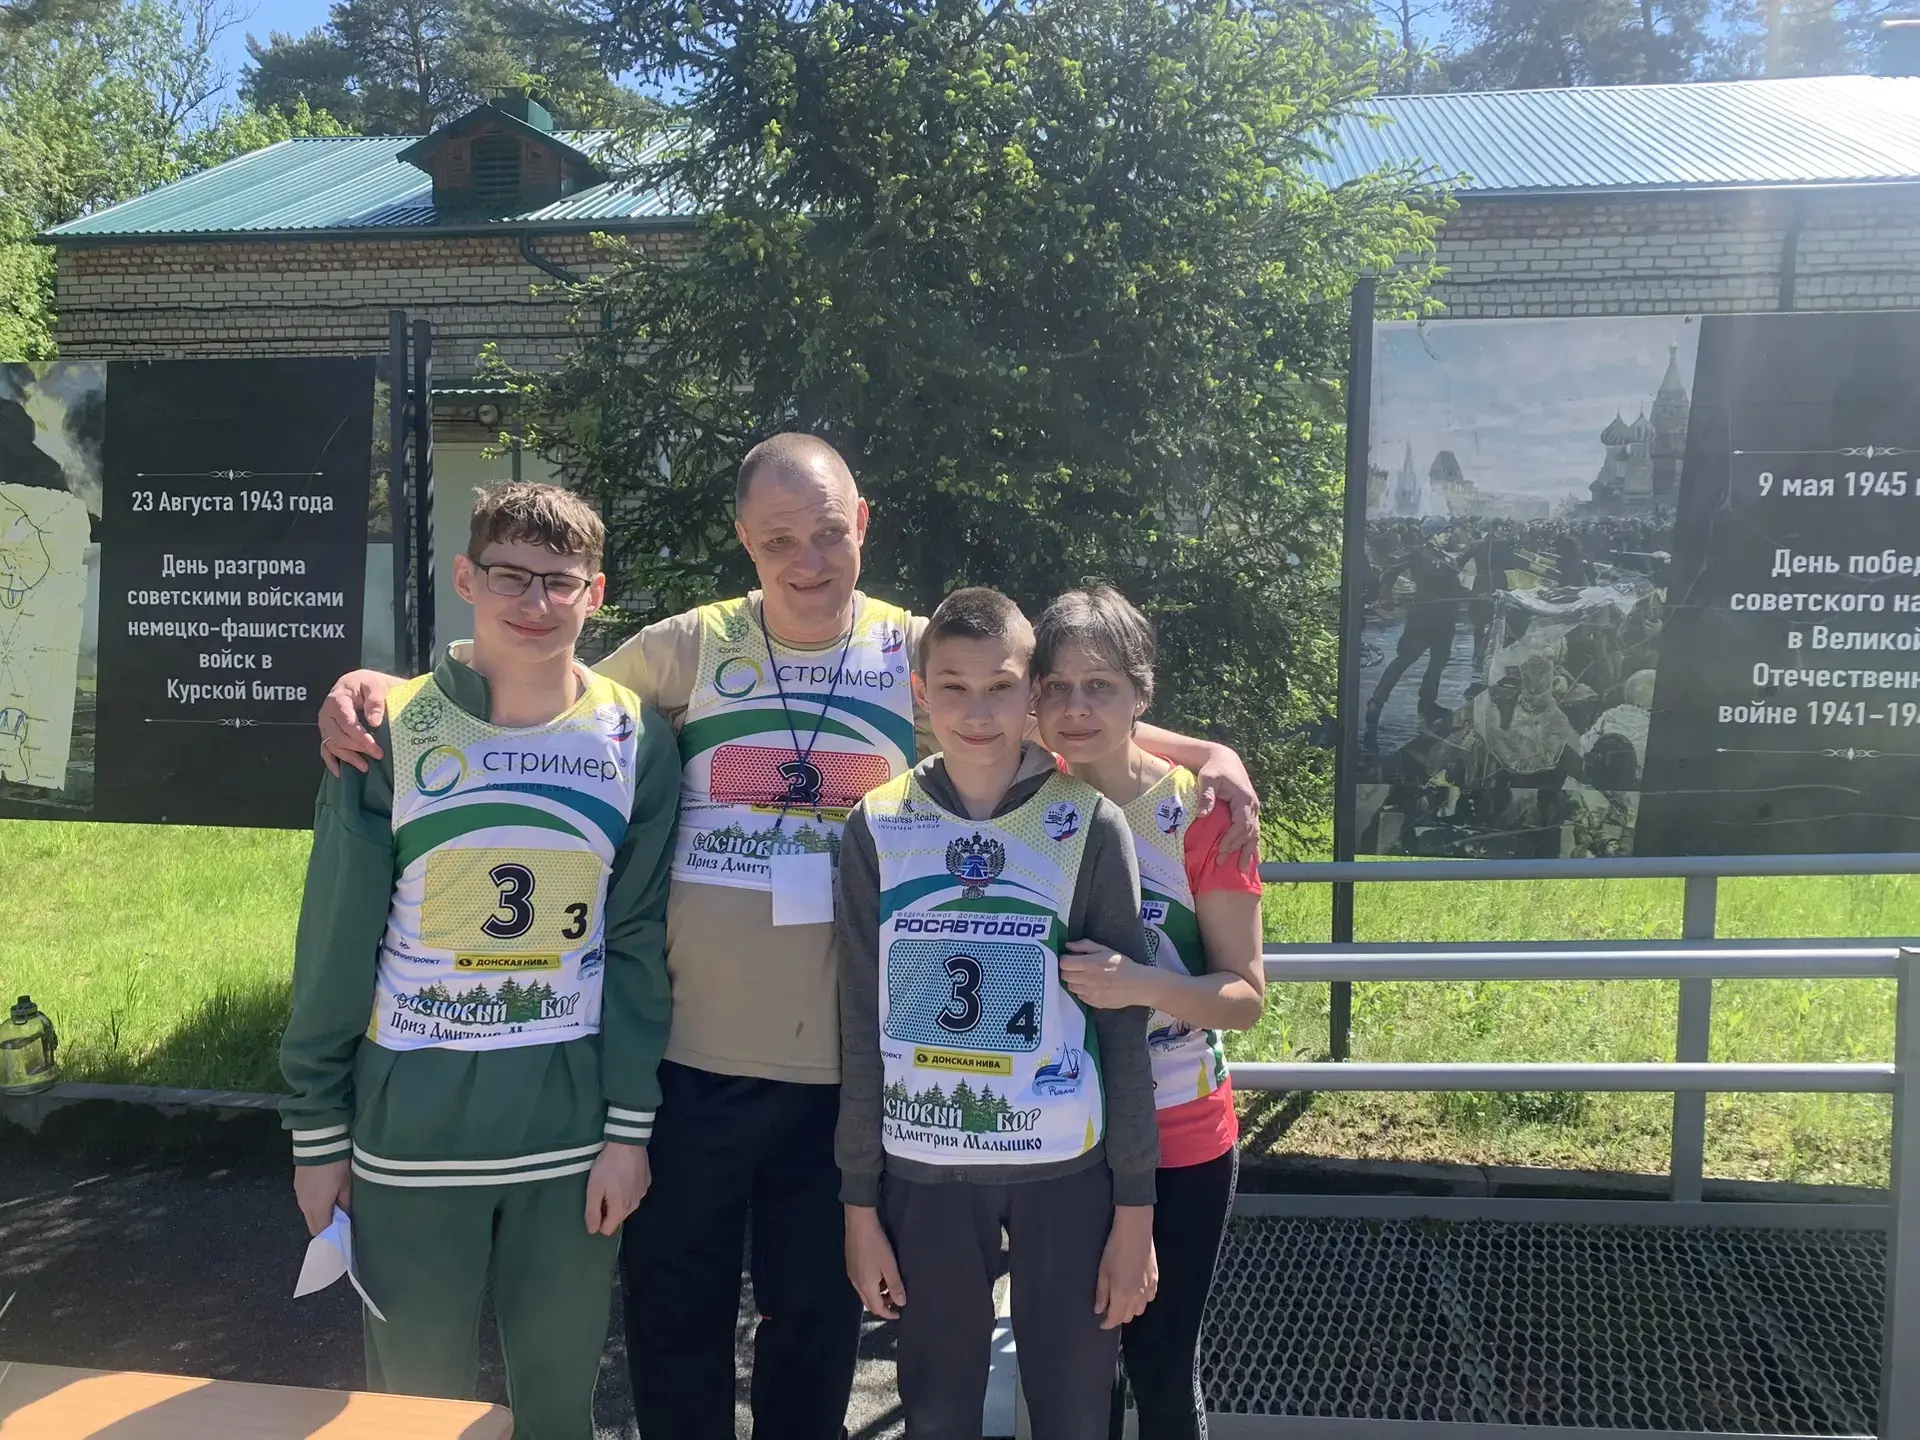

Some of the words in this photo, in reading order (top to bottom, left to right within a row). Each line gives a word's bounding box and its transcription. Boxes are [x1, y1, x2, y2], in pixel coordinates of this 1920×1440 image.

[1758, 471, 1774, 497] 9
[1782, 478, 1835, 497] мая
[1844, 471, 1908, 497] 1945
[131, 490, 154, 512] 23
[158, 491, 234, 517] Августа
[239, 490, 284, 512] 1943
[289, 494, 334, 514] года
[161, 553, 209, 578] День
[214, 559, 306, 580] разгрома
[1771, 548, 1840, 578] День
[127, 589, 242, 607] советскими
[247, 585, 344, 608] войсками
[1730, 592, 1885, 612] советского
[128, 617, 346, 642] немецко-фашистских
[1787, 631, 1803, 649] в
[199, 648, 257, 669] войск
[261, 654, 273, 669] в
[167, 678, 247, 703] Курской
[252, 679, 308, 701] битве
[1718, 700, 1798, 725] войне
[914, 812, 941, 824] Realty
[481, 862, 536, 940] 3
[561, 902, 589, 940] 3
[893, 918, 1046, 938] РОСАВТОДОР
[476, 958, 522, 967] ДОНСКАЯ
[523, 957, 549, 967] НИВА
[937, 954, 984, 1033] 3
[390, 1010, 427, 1036] Приз
[1007, 1000, 1039, 1043] 4
[931, 1055, 974, 1067] ДОНСКАЯ
[975, 1059, 1001, 1069] НИВА
[894, 1123, 958, 1149] Дмитрия
[962, 1134, 1043, 1151] Малышко
